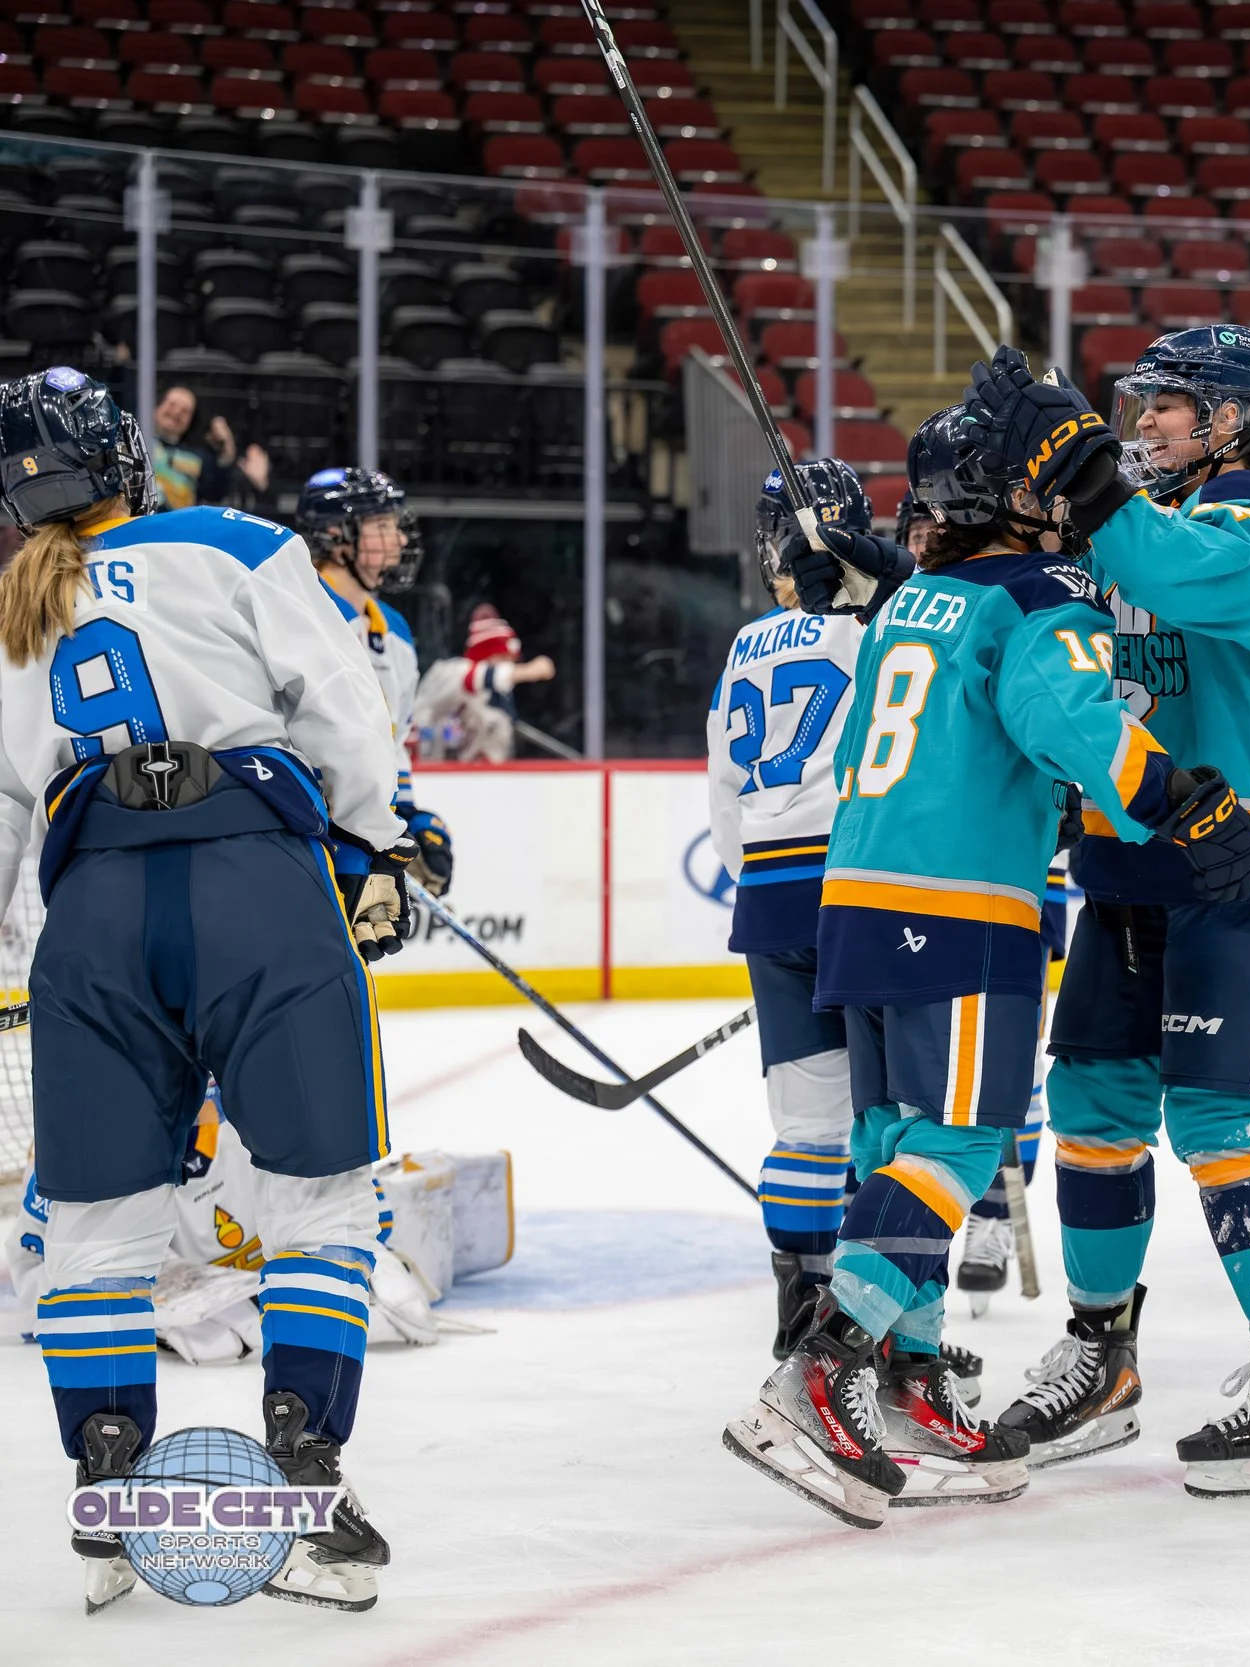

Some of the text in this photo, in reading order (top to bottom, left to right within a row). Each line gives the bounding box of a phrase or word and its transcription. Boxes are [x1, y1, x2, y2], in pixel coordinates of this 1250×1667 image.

[1135, 362, 1156, 373] CCM
[1026, 412, 1105, 480] CCM
[1191, 427, 1212, 438] CCM
[1213, 438, 1240, 460] CCM
[22, 456, 39, 476] 9
[821, 505, 841, 523] 27
[732, 616, 825, 671] MALTAIS
[49, 616, 170, 765] 9
[725, 658, 853, 798] 27
[1189, 787, 1238, 840] CC
[1161, 1014, 1224, 1035] CCM
[1100, 1377, 1132, 1414] CCM
[819, 1405, 852, 1450] BAUER
[335, 1508, 364, 1537] BAUER
